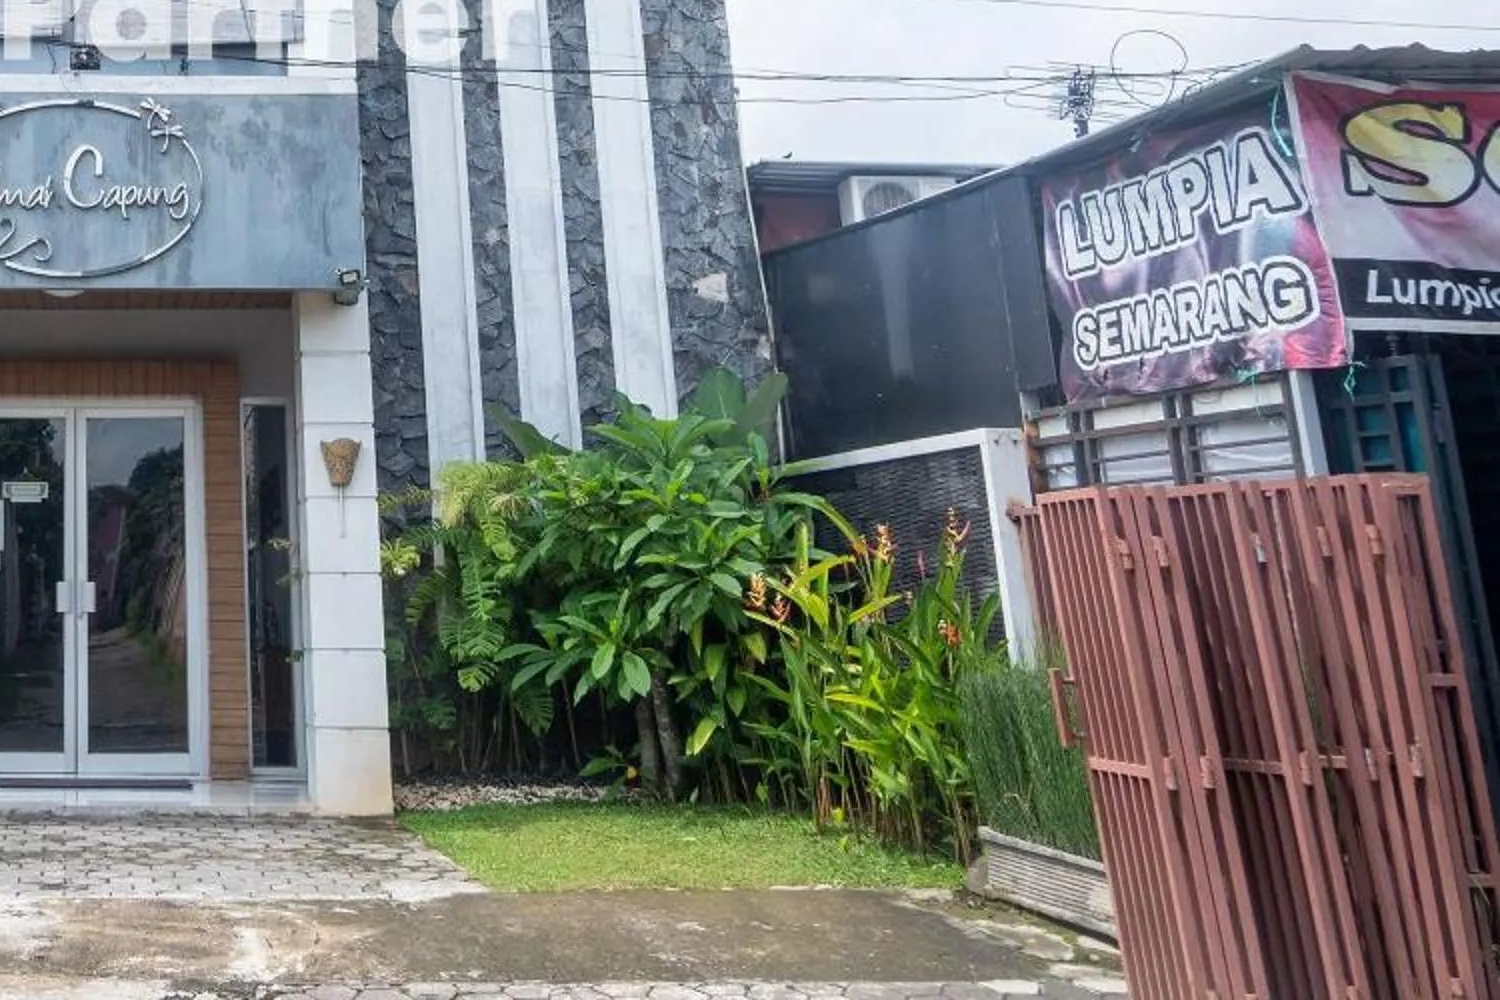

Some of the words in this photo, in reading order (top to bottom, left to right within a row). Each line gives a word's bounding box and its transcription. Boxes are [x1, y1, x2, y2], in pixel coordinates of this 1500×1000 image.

[64, 144, 190, 220] Capung
[1059, 131, 1299, 276] LUMPIA
[1339, 102, 1500, 208] S
[1075, 261, 1312, 365] SEMARANG
